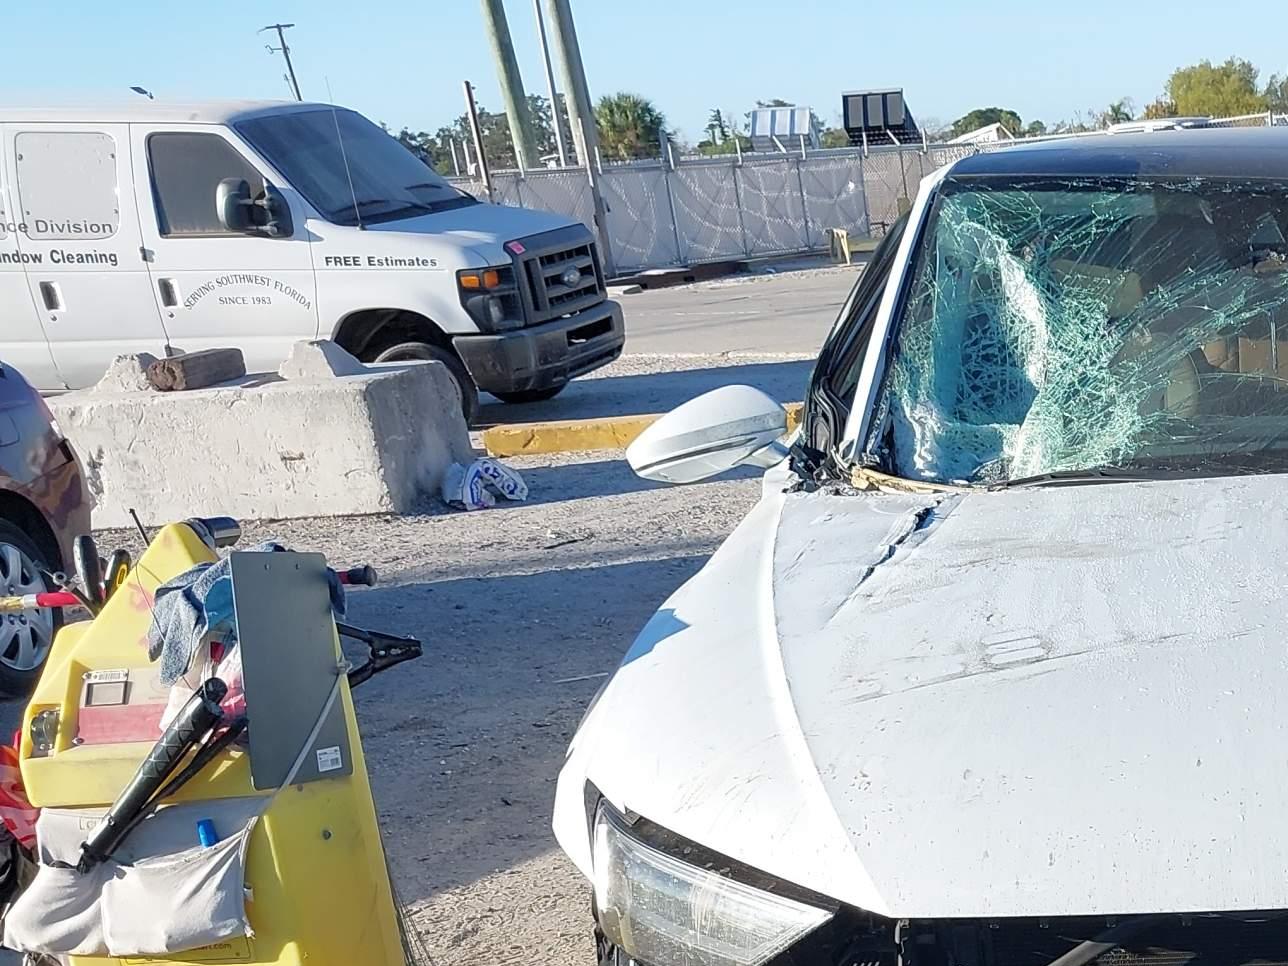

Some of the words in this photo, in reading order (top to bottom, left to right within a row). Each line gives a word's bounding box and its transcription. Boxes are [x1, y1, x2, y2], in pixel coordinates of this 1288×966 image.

[35, 219, 113, 233] Division
[0, 249, 42, 264] ndow
[49, 249, 118, 266] Cleaning
[324, 256, 362, 267] FREE
[366, 256, 438, 267] Estimates
[183, 281, 216, 310] SERVING
[215, 274, 272, 288] SOUTHWEST
[273, 280, 312, 310] FLORIDA
[218, 296, 249, 305] SINCE
[251, 296, 272, 305] 1983
